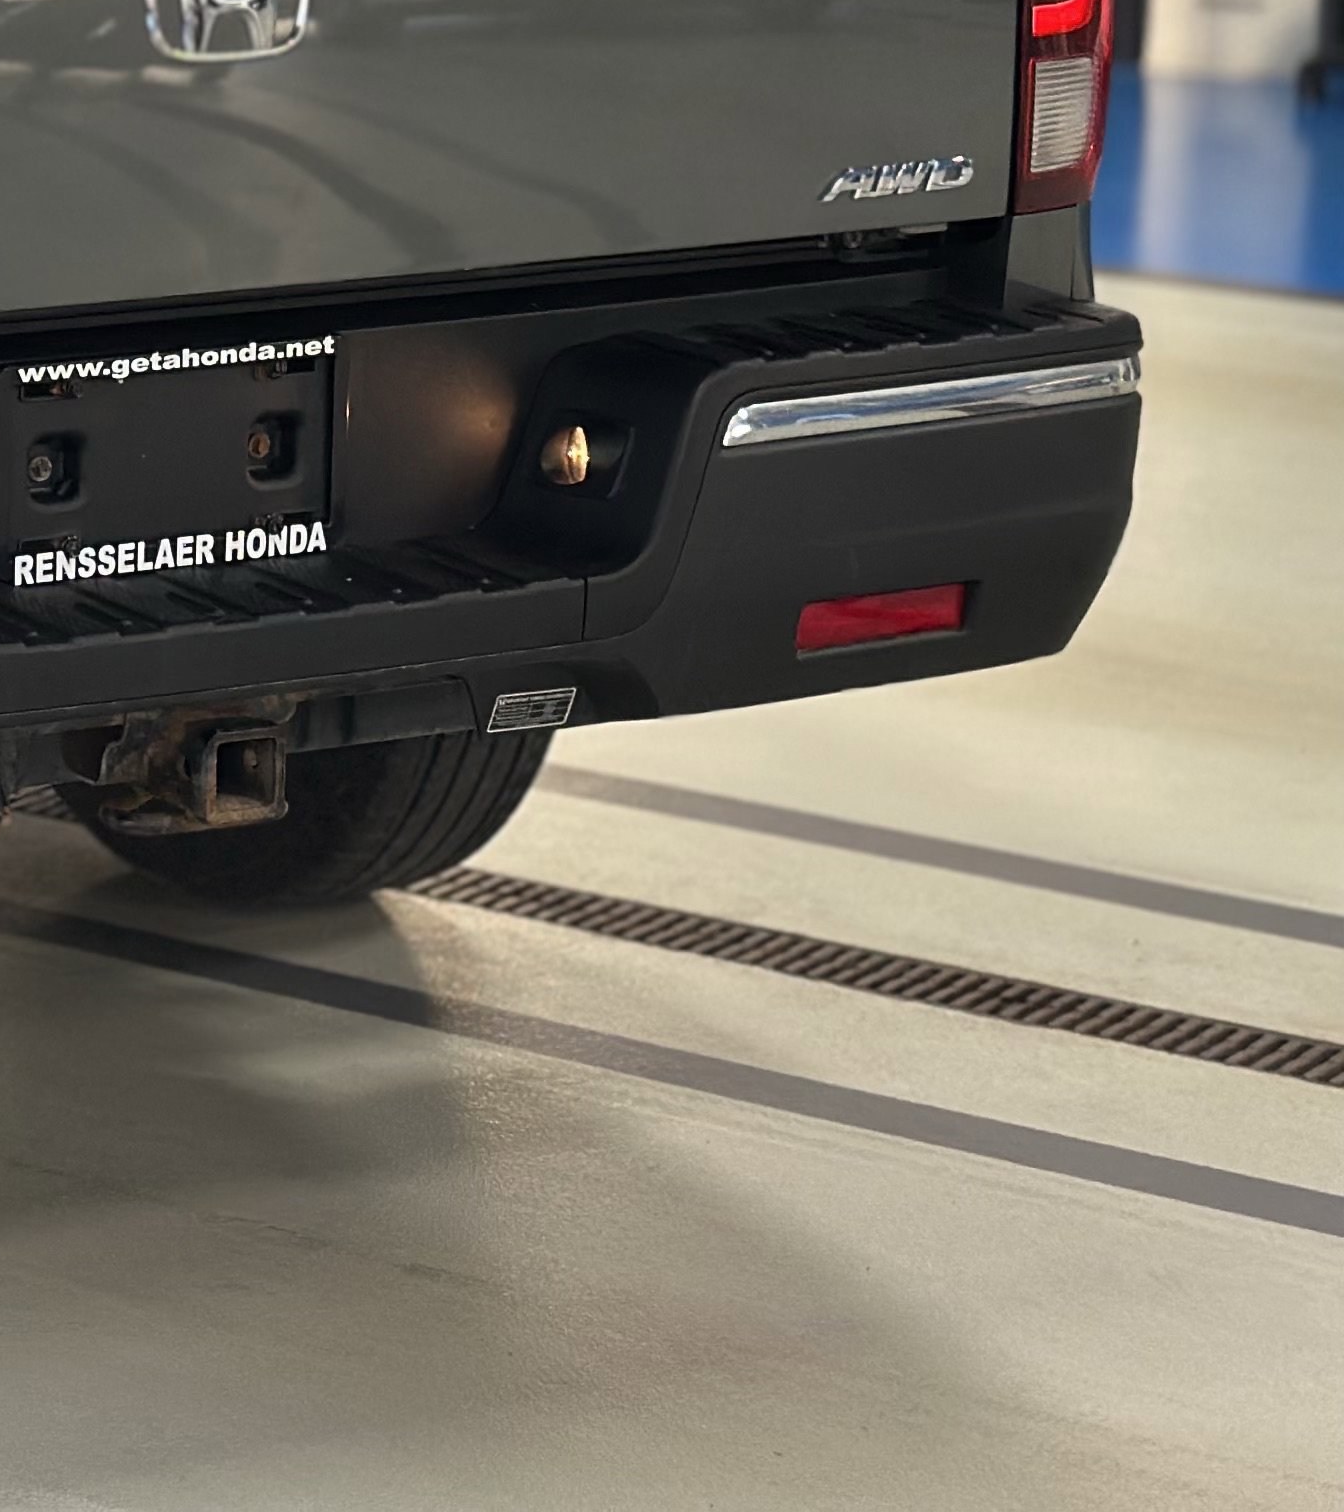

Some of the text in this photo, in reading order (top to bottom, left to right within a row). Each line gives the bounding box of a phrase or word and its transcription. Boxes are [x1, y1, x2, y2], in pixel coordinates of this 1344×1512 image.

[819, 155, 973, 202] AWD
[18, 335, 335, 384] www.getahonda.net
[14, 521, 327, 587] RENSSELAER HONDA
